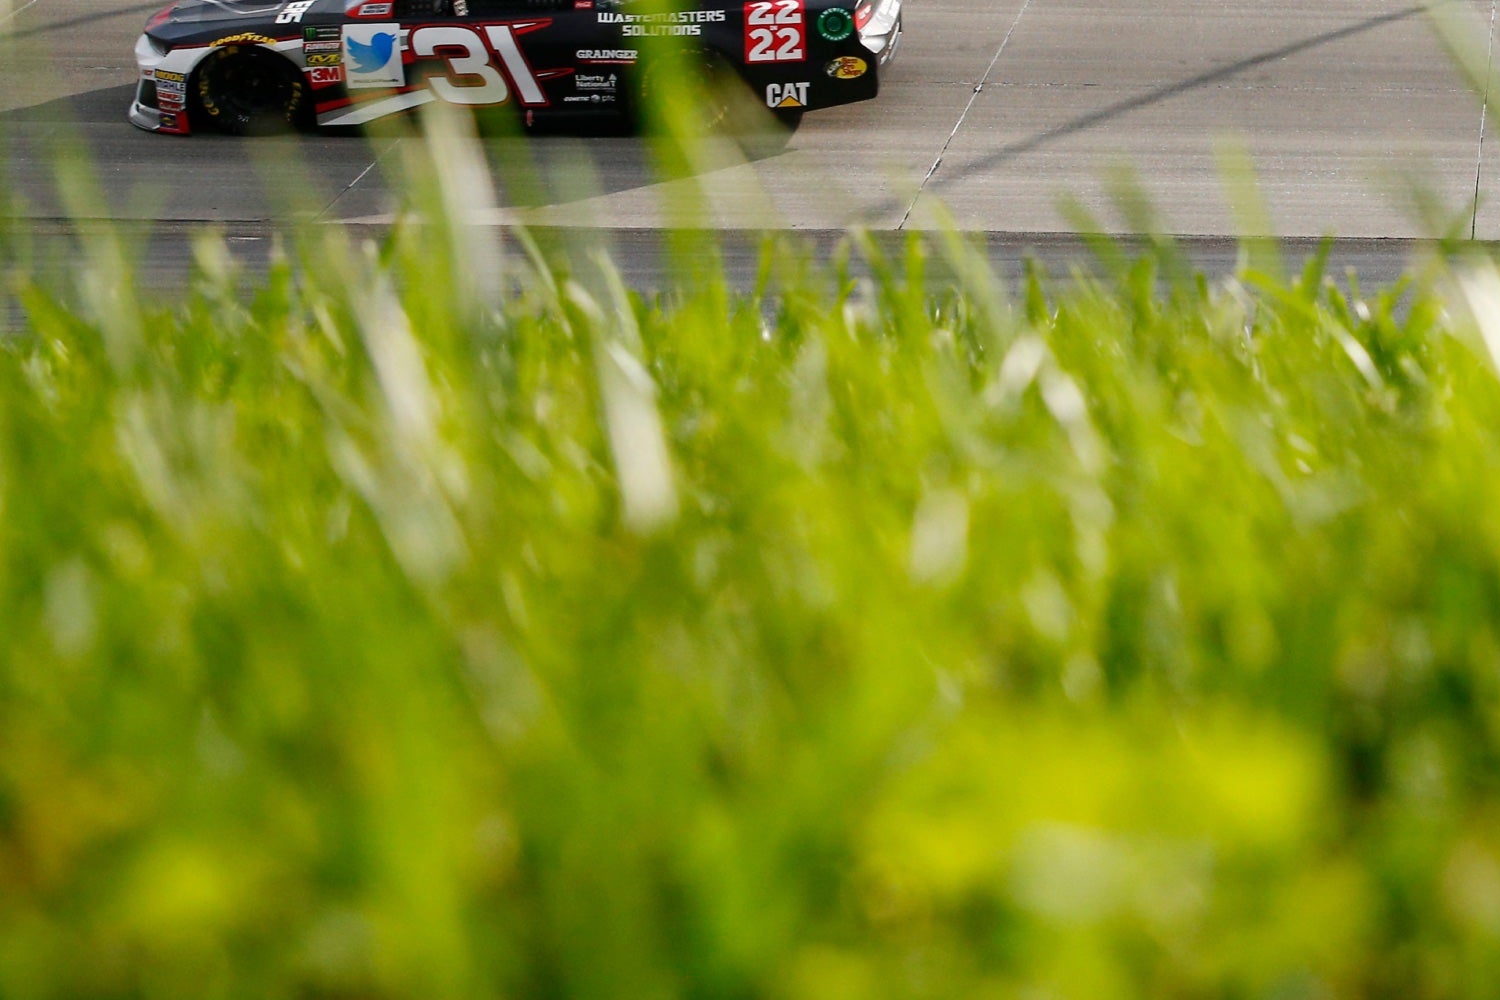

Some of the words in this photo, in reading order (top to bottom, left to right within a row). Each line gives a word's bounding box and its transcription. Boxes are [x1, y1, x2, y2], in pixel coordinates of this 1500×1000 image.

[748, 0, 802, 25] 22
[209, 32, 277, 48] GOODYEAR
[749, 28, 803, 61] 22
[406, 21, 549, 105] 31
[576, 49, 639, 59] GRAINGER
[312, 67, 340, 81] 3M
[575, 74, 605, 82] Liberty
[766, 82, 811, 108] CAT
